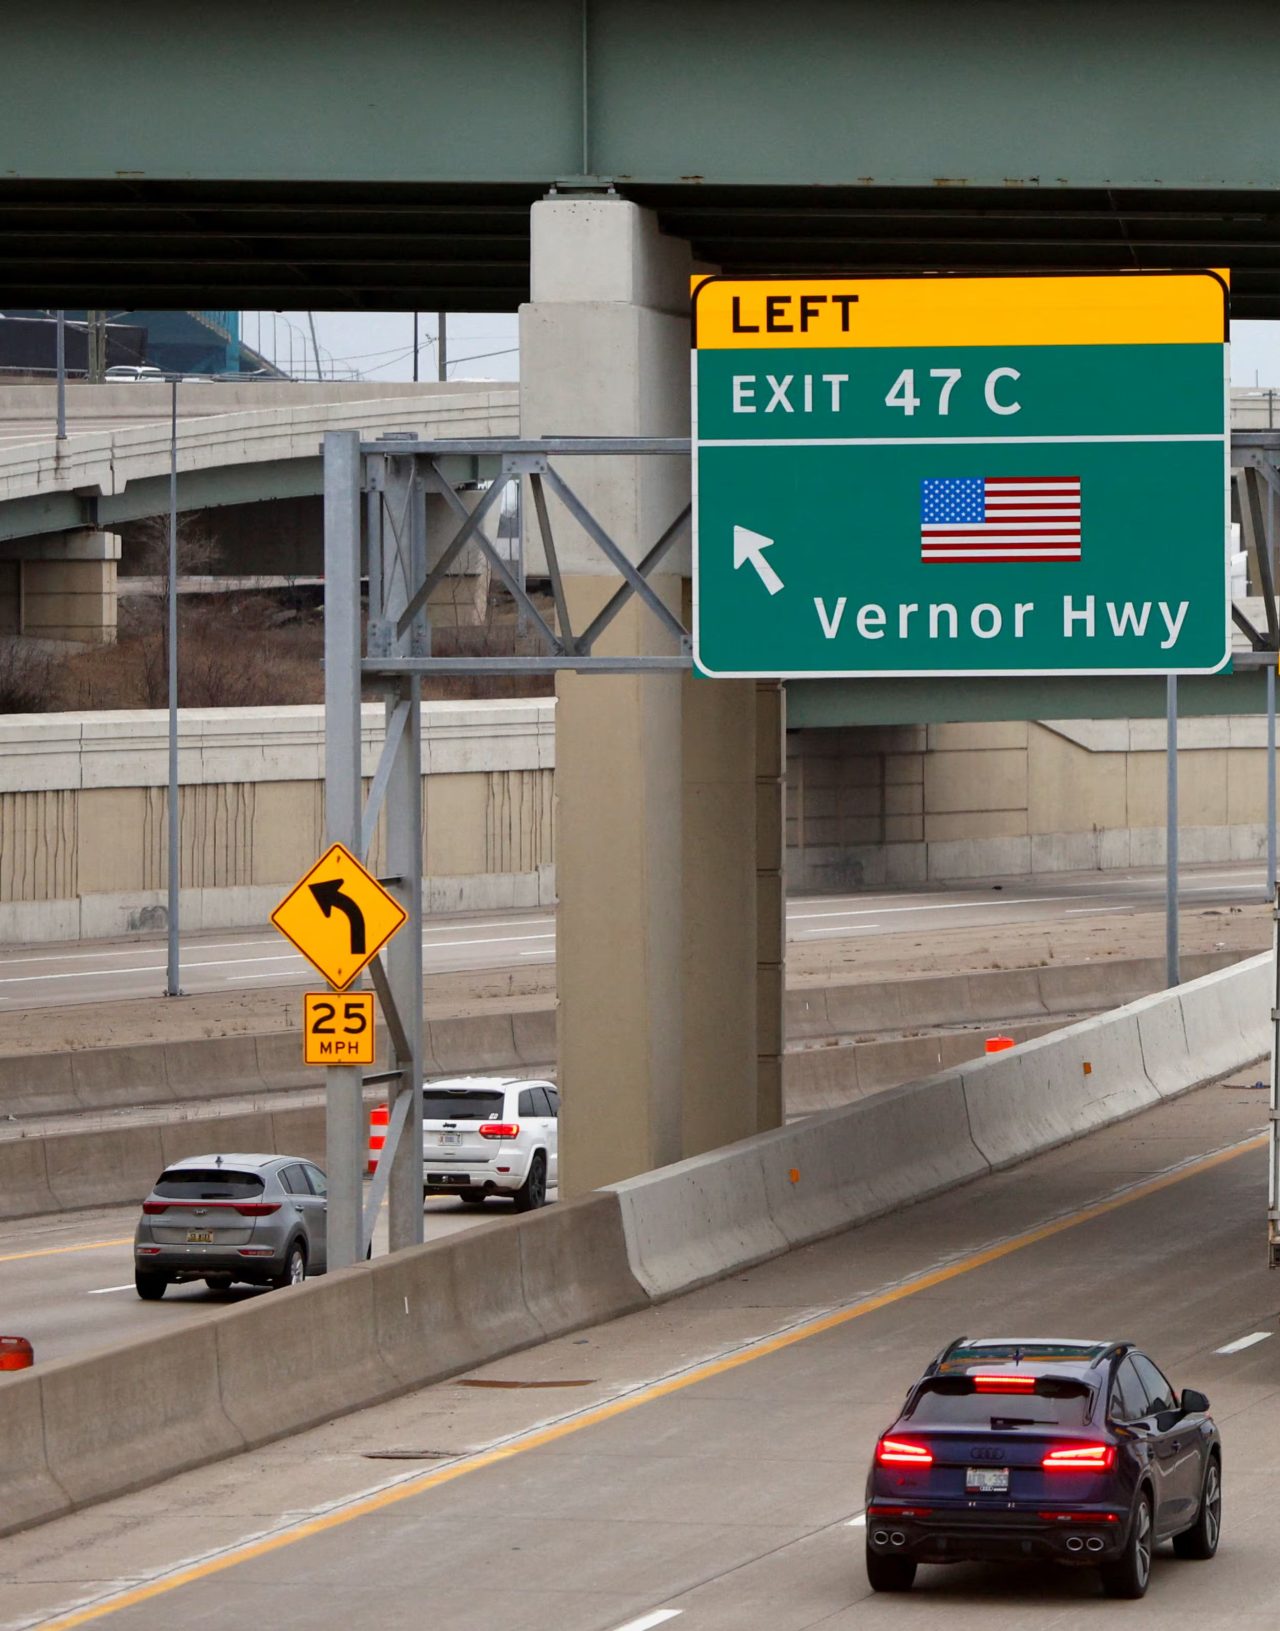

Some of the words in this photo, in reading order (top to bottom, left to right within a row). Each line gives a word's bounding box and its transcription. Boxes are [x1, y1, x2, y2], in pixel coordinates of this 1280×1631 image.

[732, 295, 859, 333] LEFT
[732, 374, 849, 412] EXIT
[885, 369, 961, 415] 47
[984, 367, 1022, 415] C
[814, 602, 1034, 640] Vernor
[1064, 595, 1190, 649] Hwy
[312, 1003, 367, 1034] 25
[320, 1041, 359, 1055] MPH
